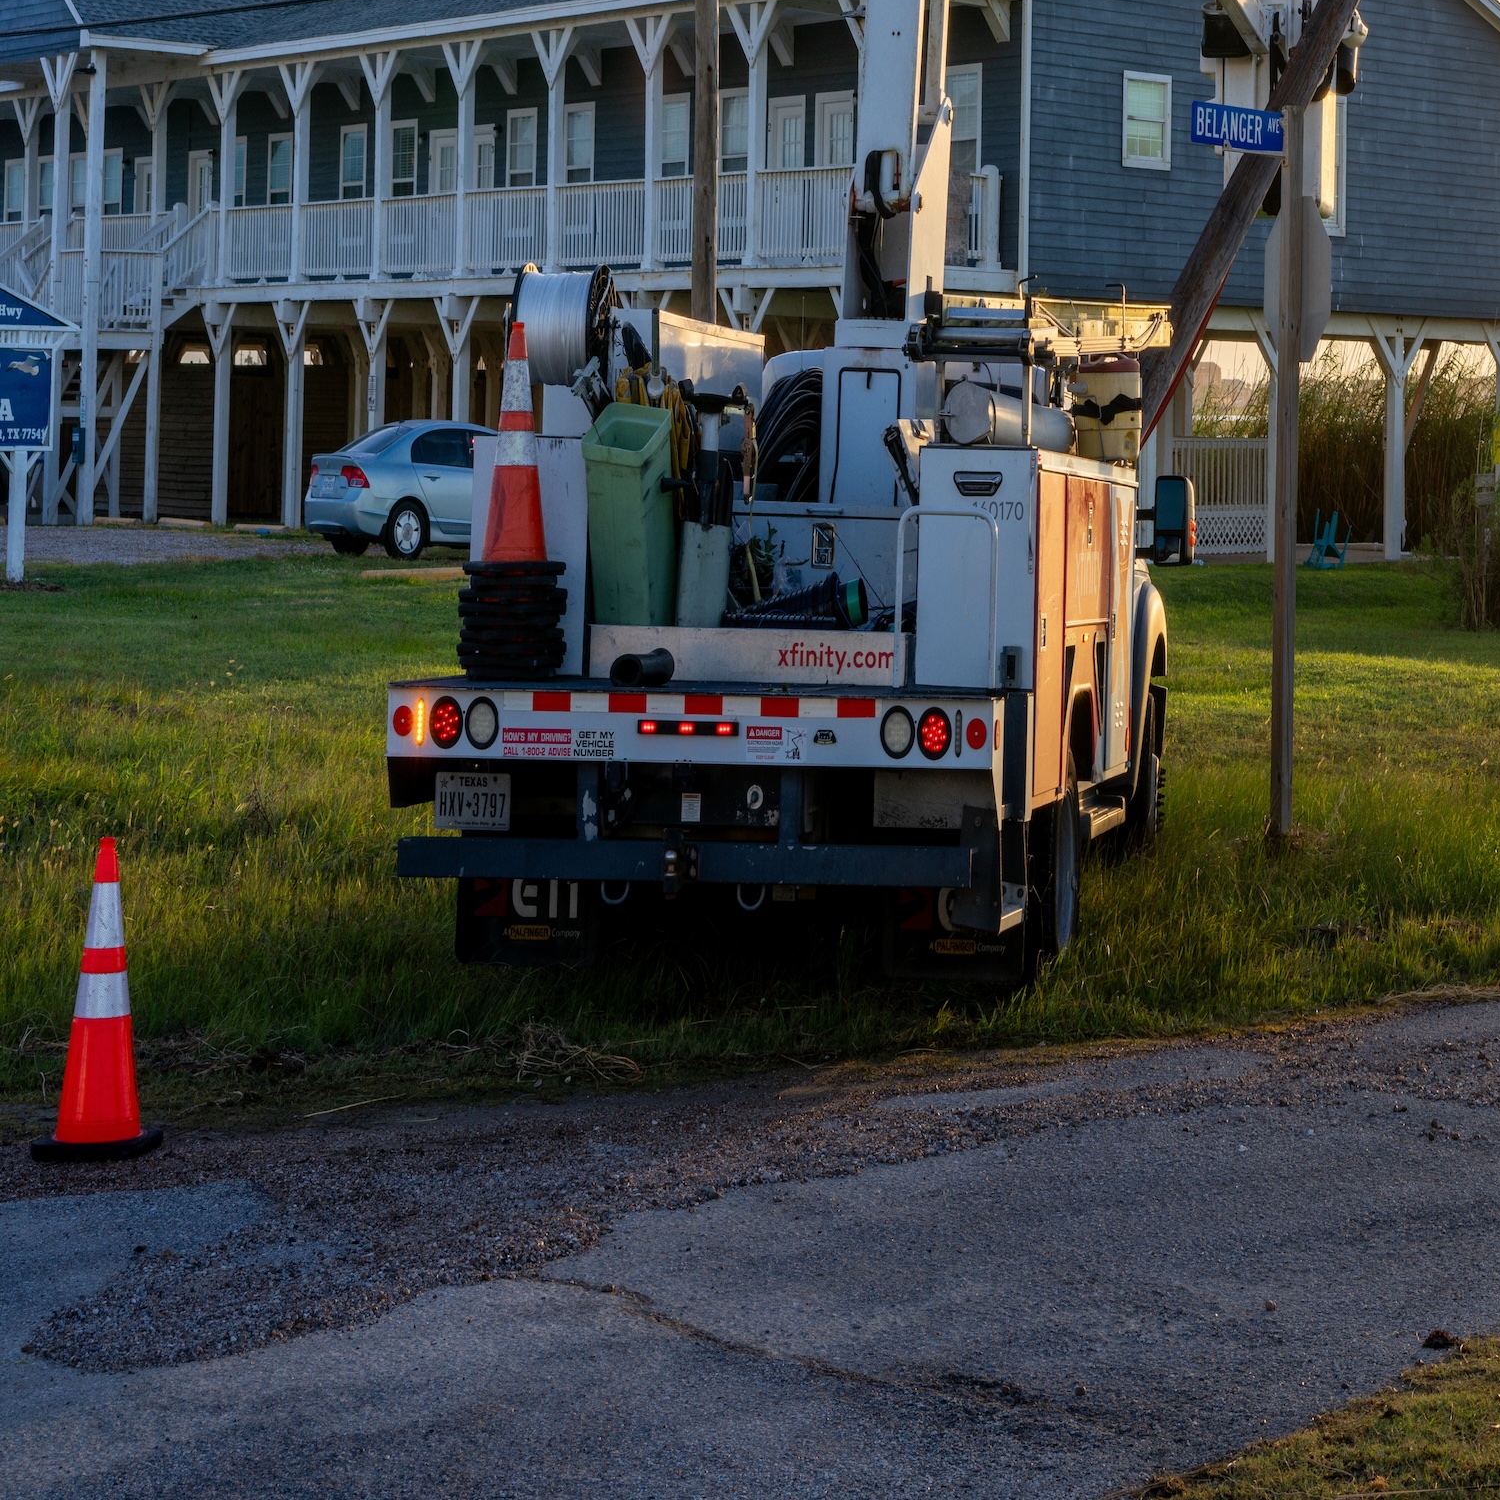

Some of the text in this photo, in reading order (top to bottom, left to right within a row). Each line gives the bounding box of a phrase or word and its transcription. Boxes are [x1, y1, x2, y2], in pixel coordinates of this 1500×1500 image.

[1196, 106, 1280, 145] BELANGER AVE
[0, 304, 23, 320] Hwy
[7, 428, 20, 440] TX
[778, 642, 894, 675] xfinity.com
[503, 731, 571, 742] HOW'S MY DRIVING?
[578, 731, 615, 739] GET MY
[755, 729, 781, 737] DANGER
[575, 740, 614, 748] VEHICLE
[503, 746, 571, 757] CALL 1-800-2 ADVISE
[573, 748, 614, 757] NUMBER
[459, 776, 488, 787] TEXAS
[440, 791, 506, 818] HXV 3797
[510, 927, 549, 938] PALFINGER
[551, 928, 581, 939] Company
[977, 942, 1006, 954] Company
